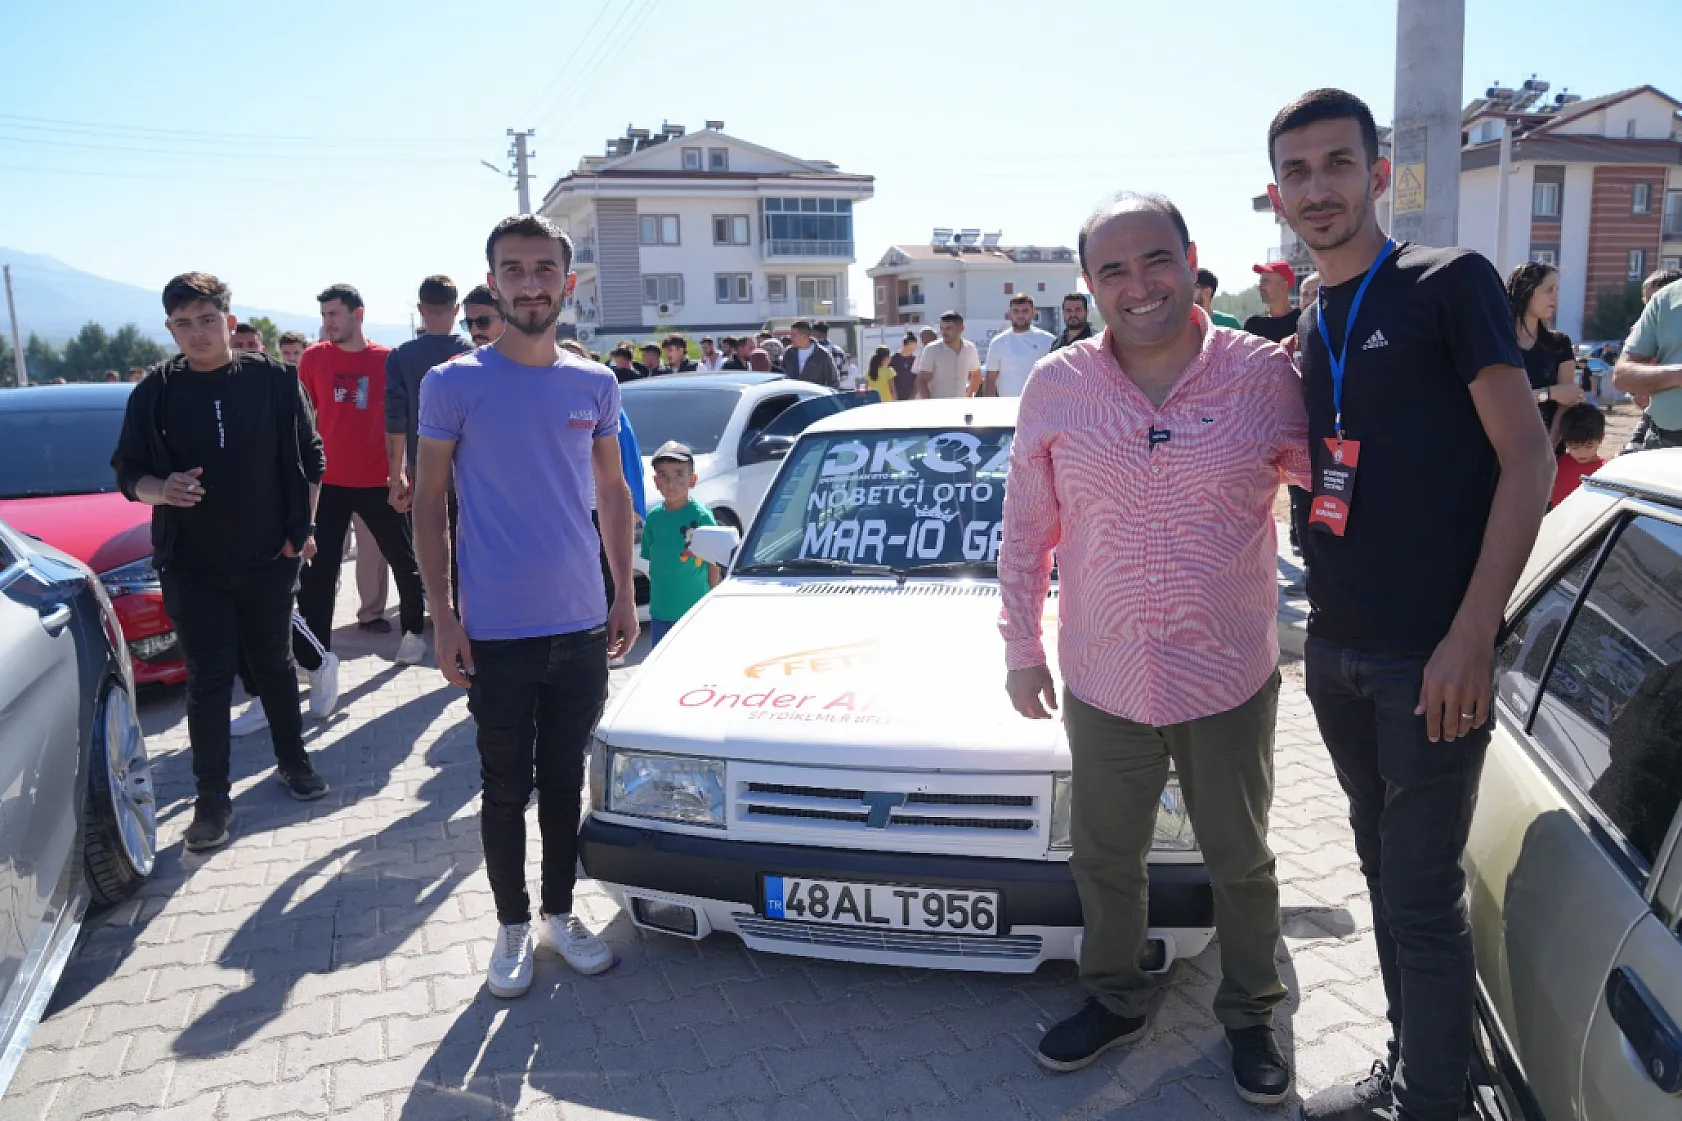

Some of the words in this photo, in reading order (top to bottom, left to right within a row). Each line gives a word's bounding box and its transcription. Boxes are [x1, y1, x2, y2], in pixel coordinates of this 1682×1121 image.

[933, 483, 993, 504] OTO
[678, 684, 816, 708] Önder
[822, 690, 874, 711] A
[768, 899, 782, 911] TR
